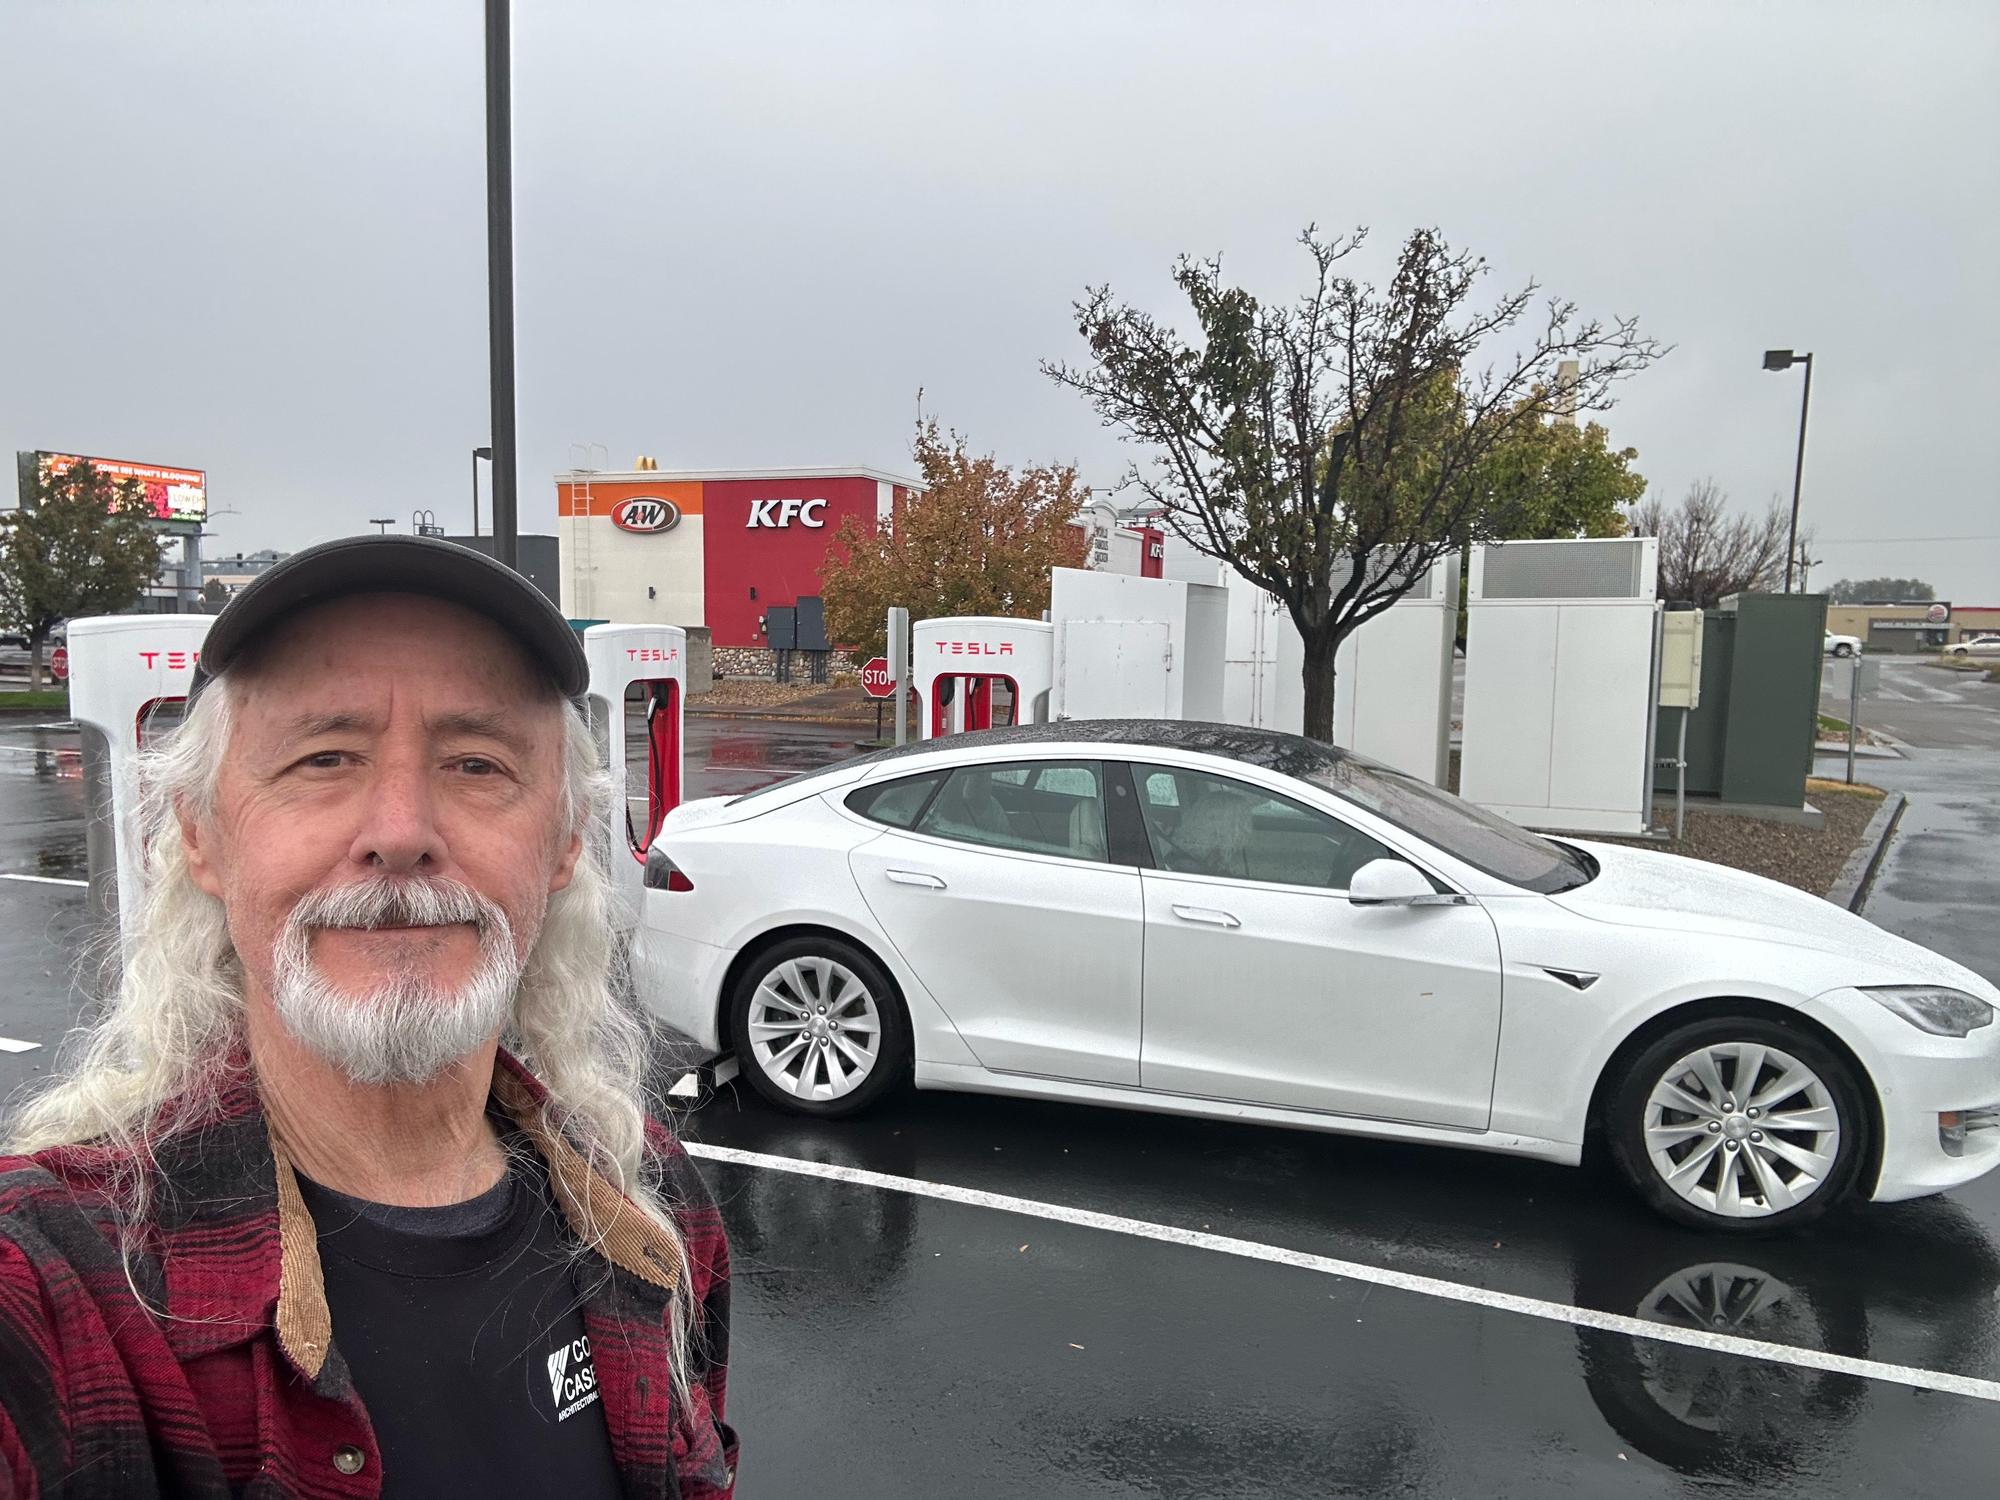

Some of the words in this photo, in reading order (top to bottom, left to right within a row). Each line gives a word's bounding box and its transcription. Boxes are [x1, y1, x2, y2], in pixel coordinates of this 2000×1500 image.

[622, 504, 666, 525] A&W
[746, 499, 827, 528] KFC
[626, 649, 678, 661] TESLA
[936, 642, 1013, 655] TESLA
[53, 656, 68, 669] STO
[864, 669, 892, 685] STO
[558, 1390, 599, 1422] ARCHITECTURAL
